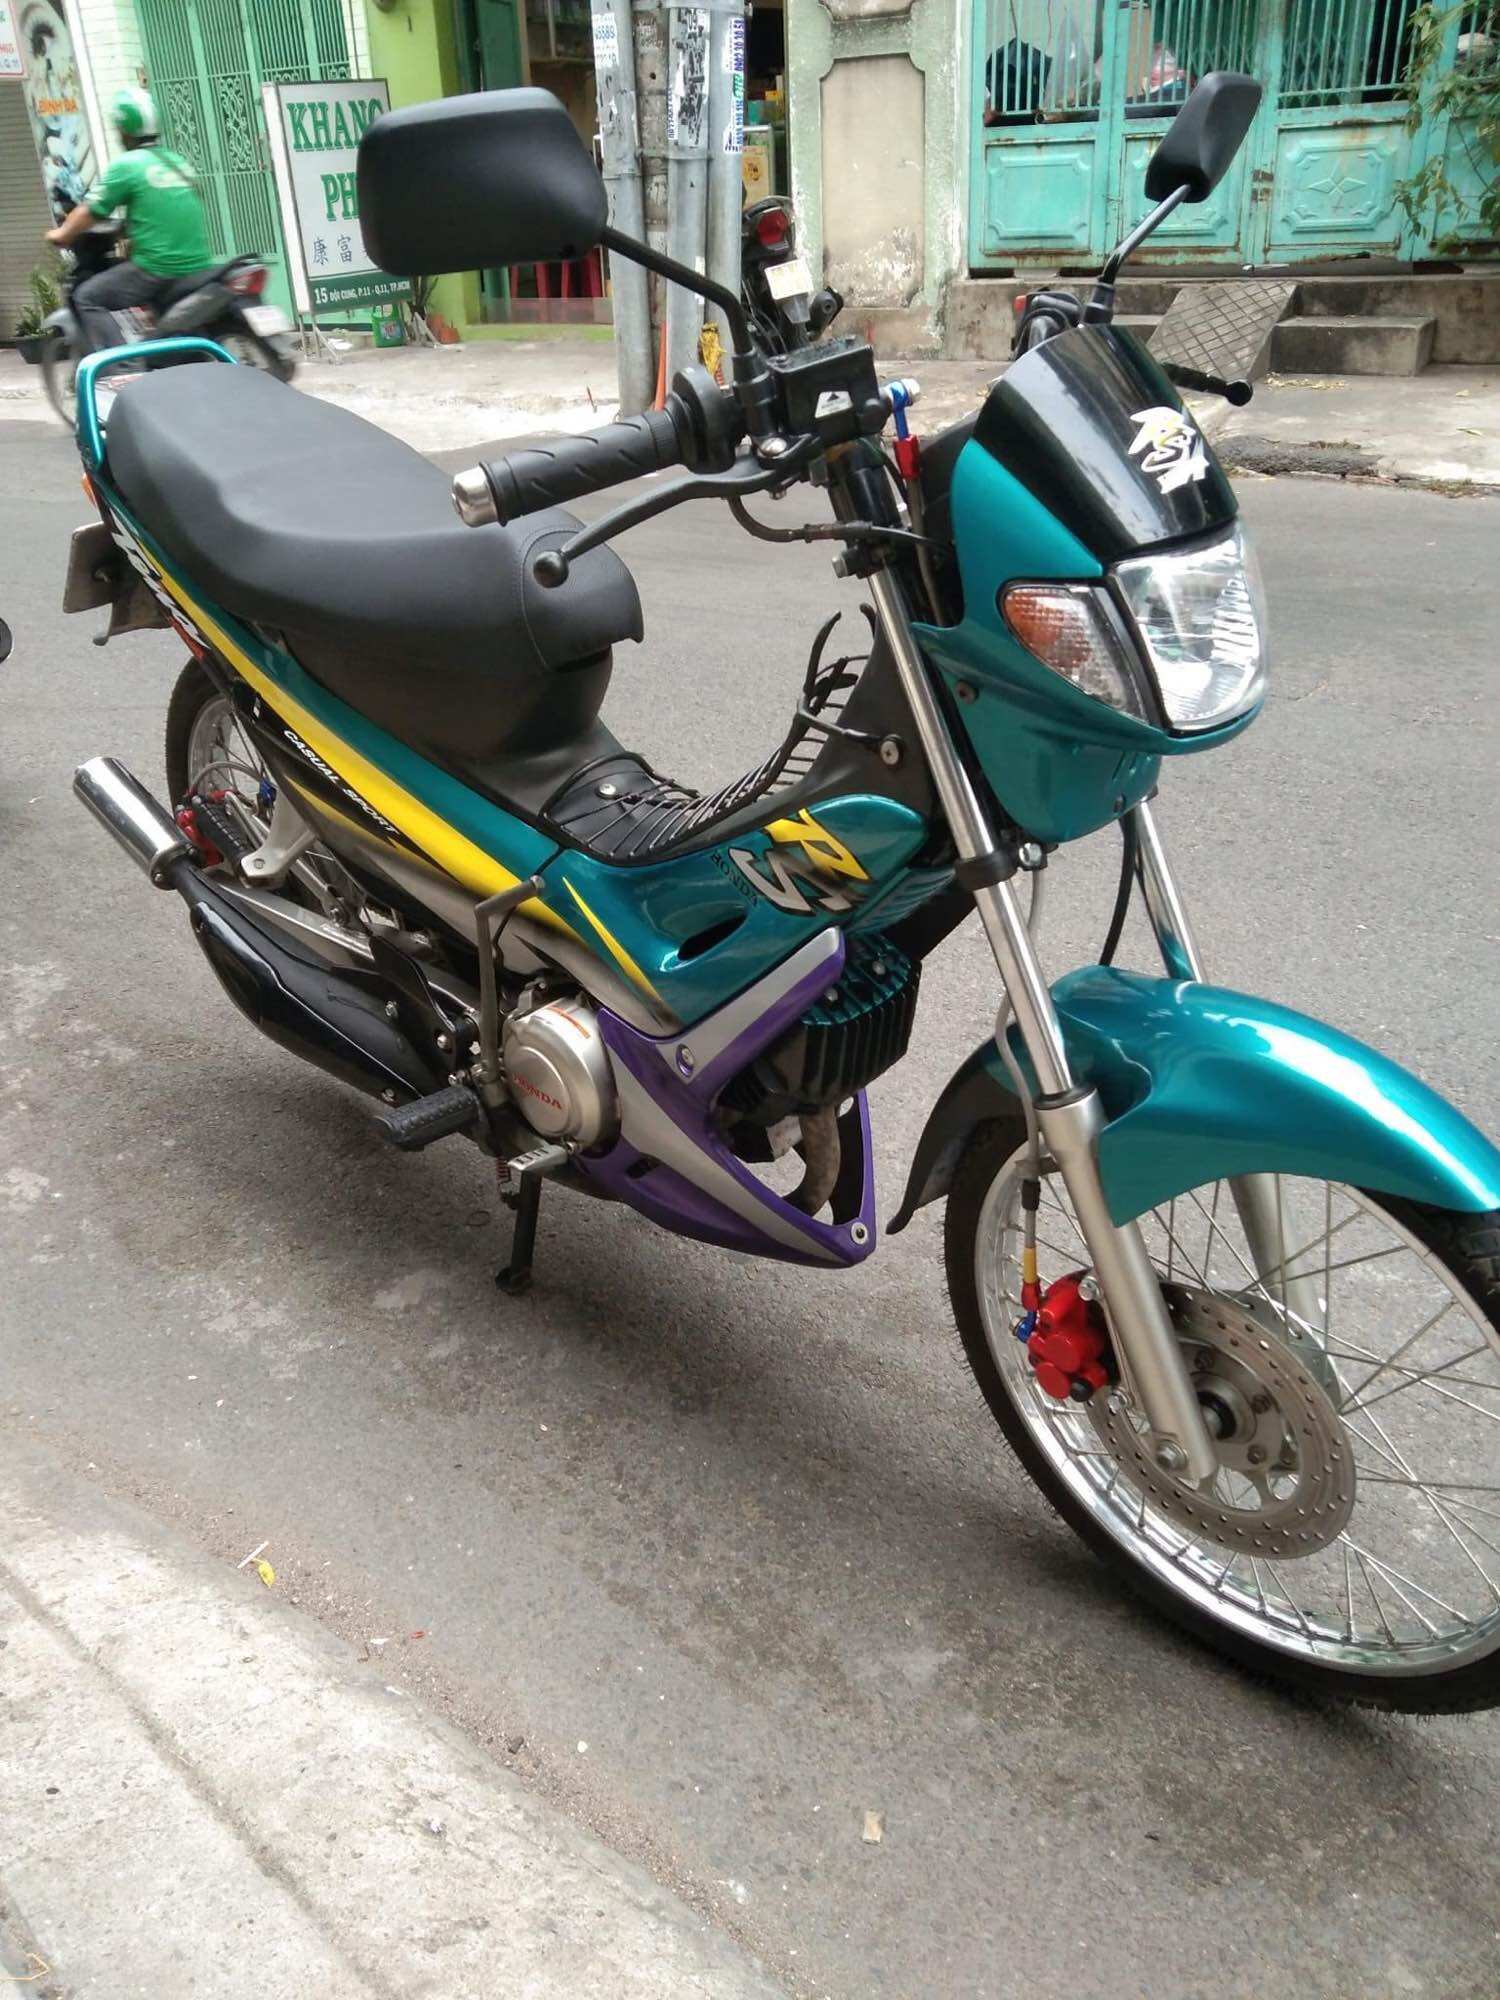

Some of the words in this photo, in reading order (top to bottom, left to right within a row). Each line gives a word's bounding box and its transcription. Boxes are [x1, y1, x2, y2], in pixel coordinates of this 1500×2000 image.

[320, 171, 359, 221] PH
[314, 287, 328, 304] 15
[284, 730, 339, 784] CASUAL
[343, 788, 400, 835] SPORT
[710, 853, 758, 907] HONDA
[512, 1072, 563, 1111] HONDA
